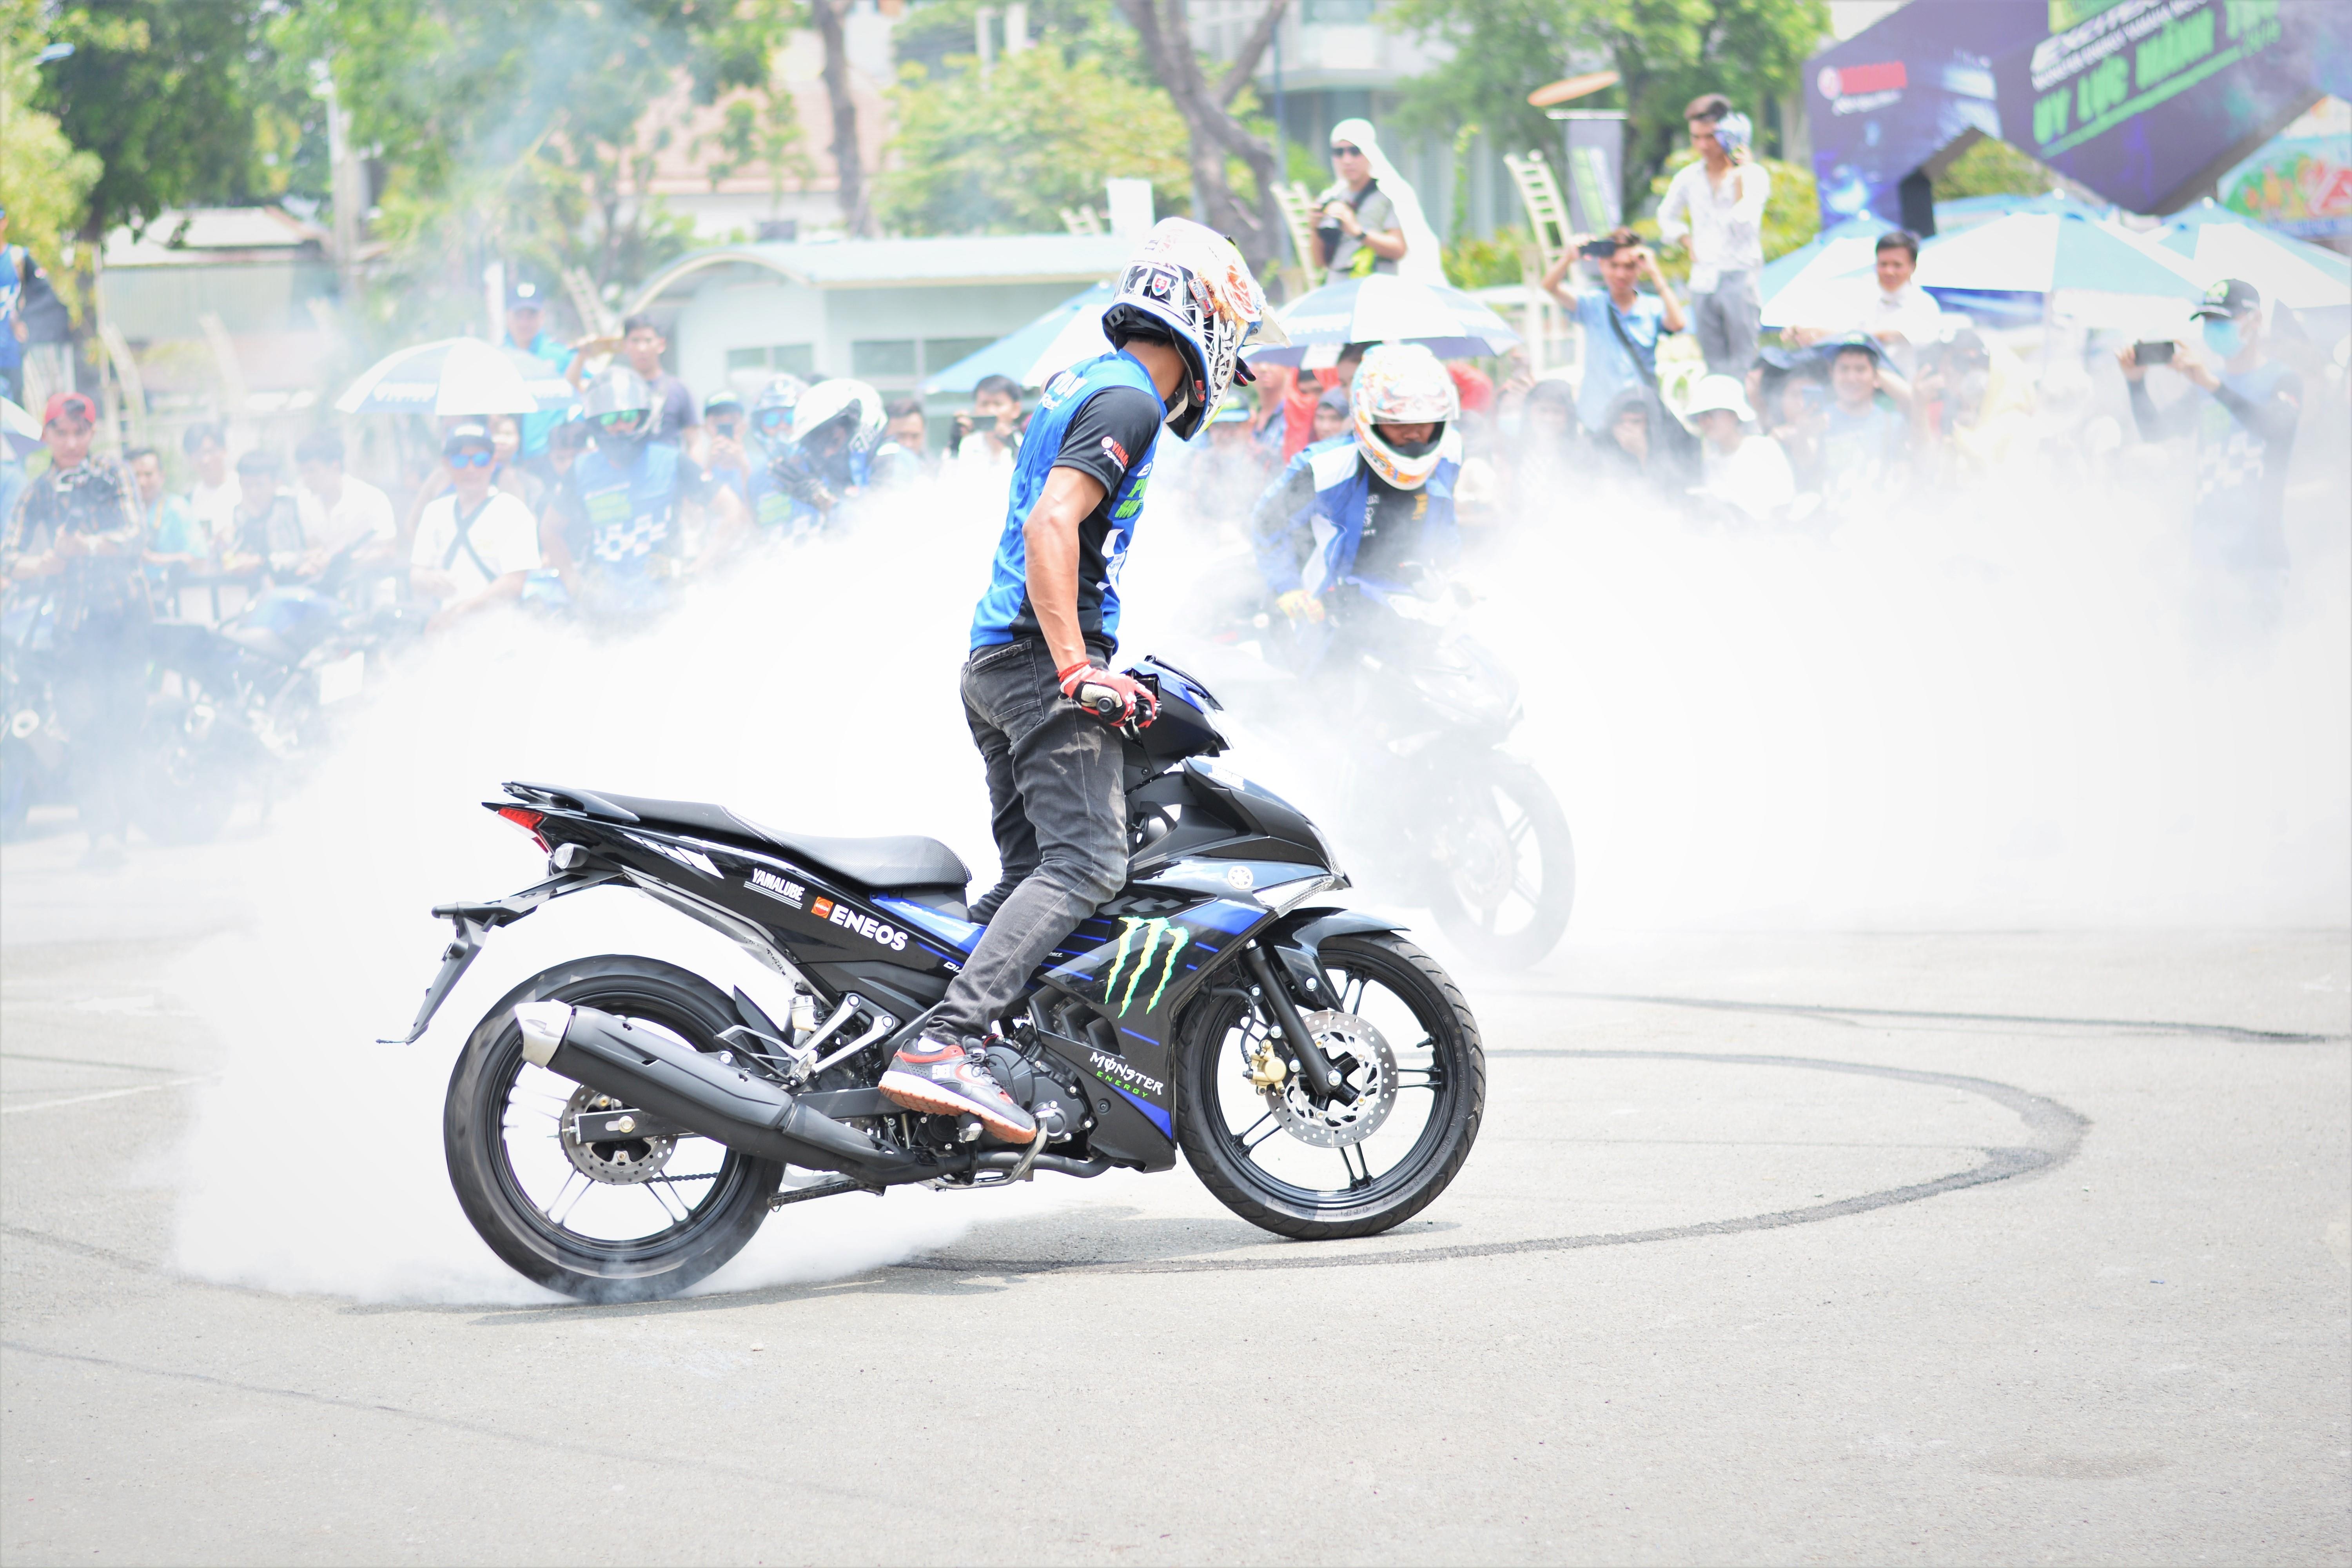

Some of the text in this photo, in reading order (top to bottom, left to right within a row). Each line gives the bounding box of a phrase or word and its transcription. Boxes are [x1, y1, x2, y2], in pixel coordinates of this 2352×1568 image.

[753, 868, 805, 901] YAMALUBE
[829, 904, 908, 951] ENEOS
[1096, 1071, 1148, 1098] ENERGY
